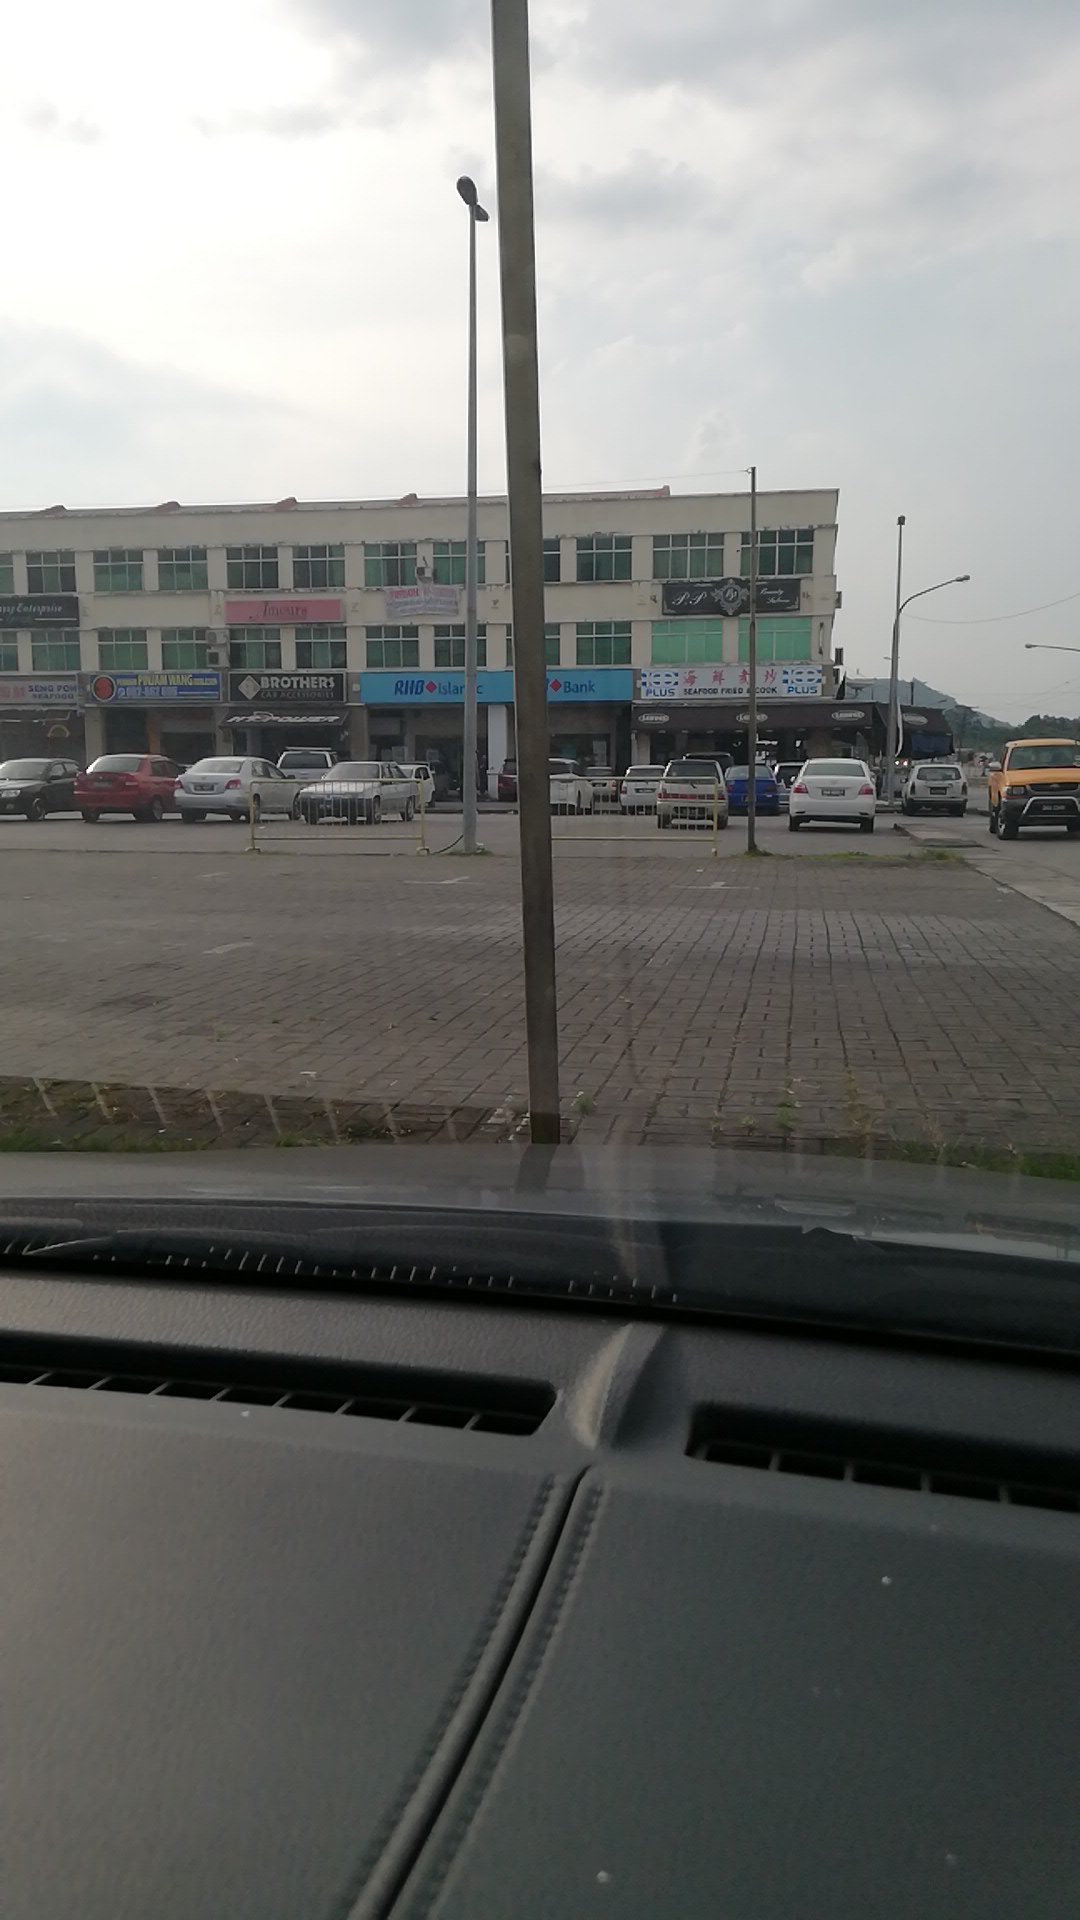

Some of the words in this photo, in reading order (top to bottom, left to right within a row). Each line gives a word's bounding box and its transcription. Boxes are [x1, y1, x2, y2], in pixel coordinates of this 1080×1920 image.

[168, 674, 193, 686] WANG
[260, 676, 335, 689] BROTHERS
[28, 684, 54, 693] SENG
[394, 679, 425, 696] RHB
[438, 680, 484, 696] Islac
[563, 680, 596, 694] Bank
[683, 688, 719, 696] SEAFOOD
[721, 687, 744, 695] FRIED
[755, 687, 778, 695] COOK
[787, 685, 818, 695] PLUS
[260, 690, 278, 699] CAR
[280, 690, 335, 699] ACCESSORIES
[645, 688, 675, 697] PLUS
